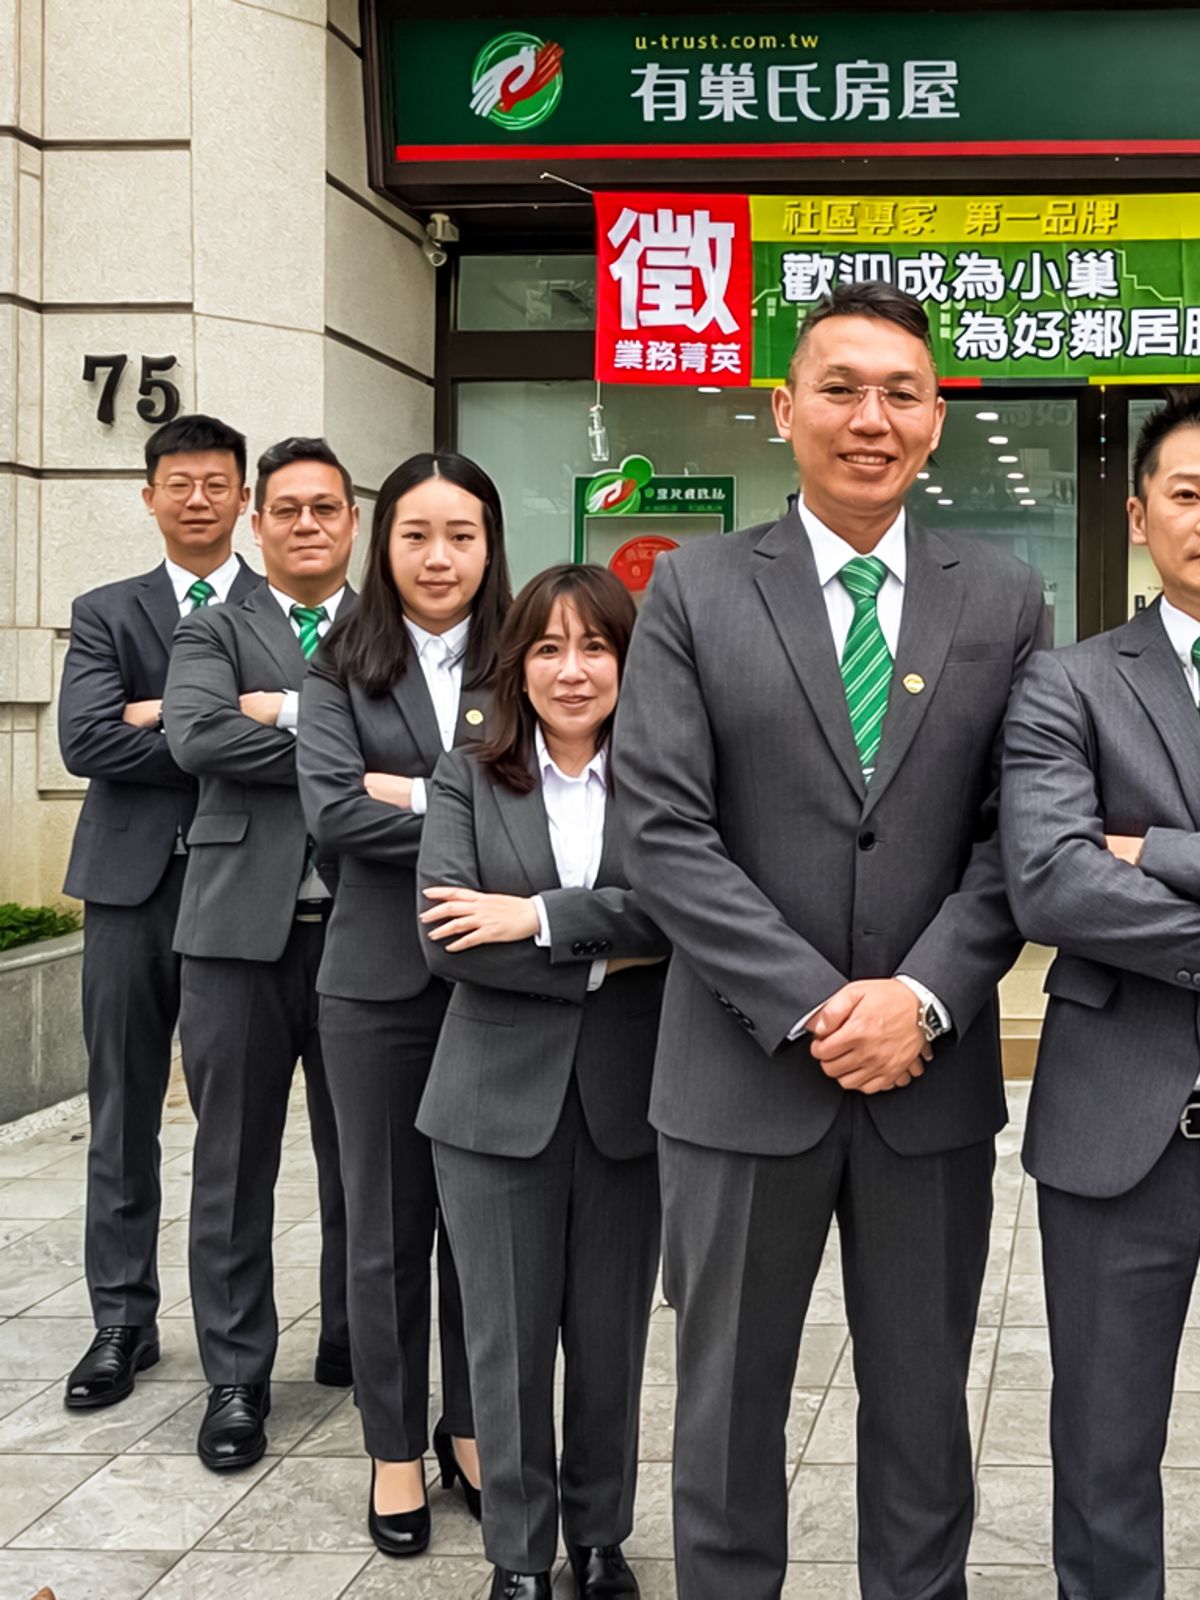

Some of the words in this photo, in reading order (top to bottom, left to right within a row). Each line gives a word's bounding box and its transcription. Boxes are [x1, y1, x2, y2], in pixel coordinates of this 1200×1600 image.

[635, 33, 819, 50] u-trust.com.tw
[631, 60, 960, 122] 有巢氏房屋
[783, 200, 938, 236] 社區專家
[963, 199, 1119, 236] 第一品牌
[607, 207, 741, 335] 徵
[613, 340, 742, 374] 業務菁英
[82, 353, 181, 426] 75
